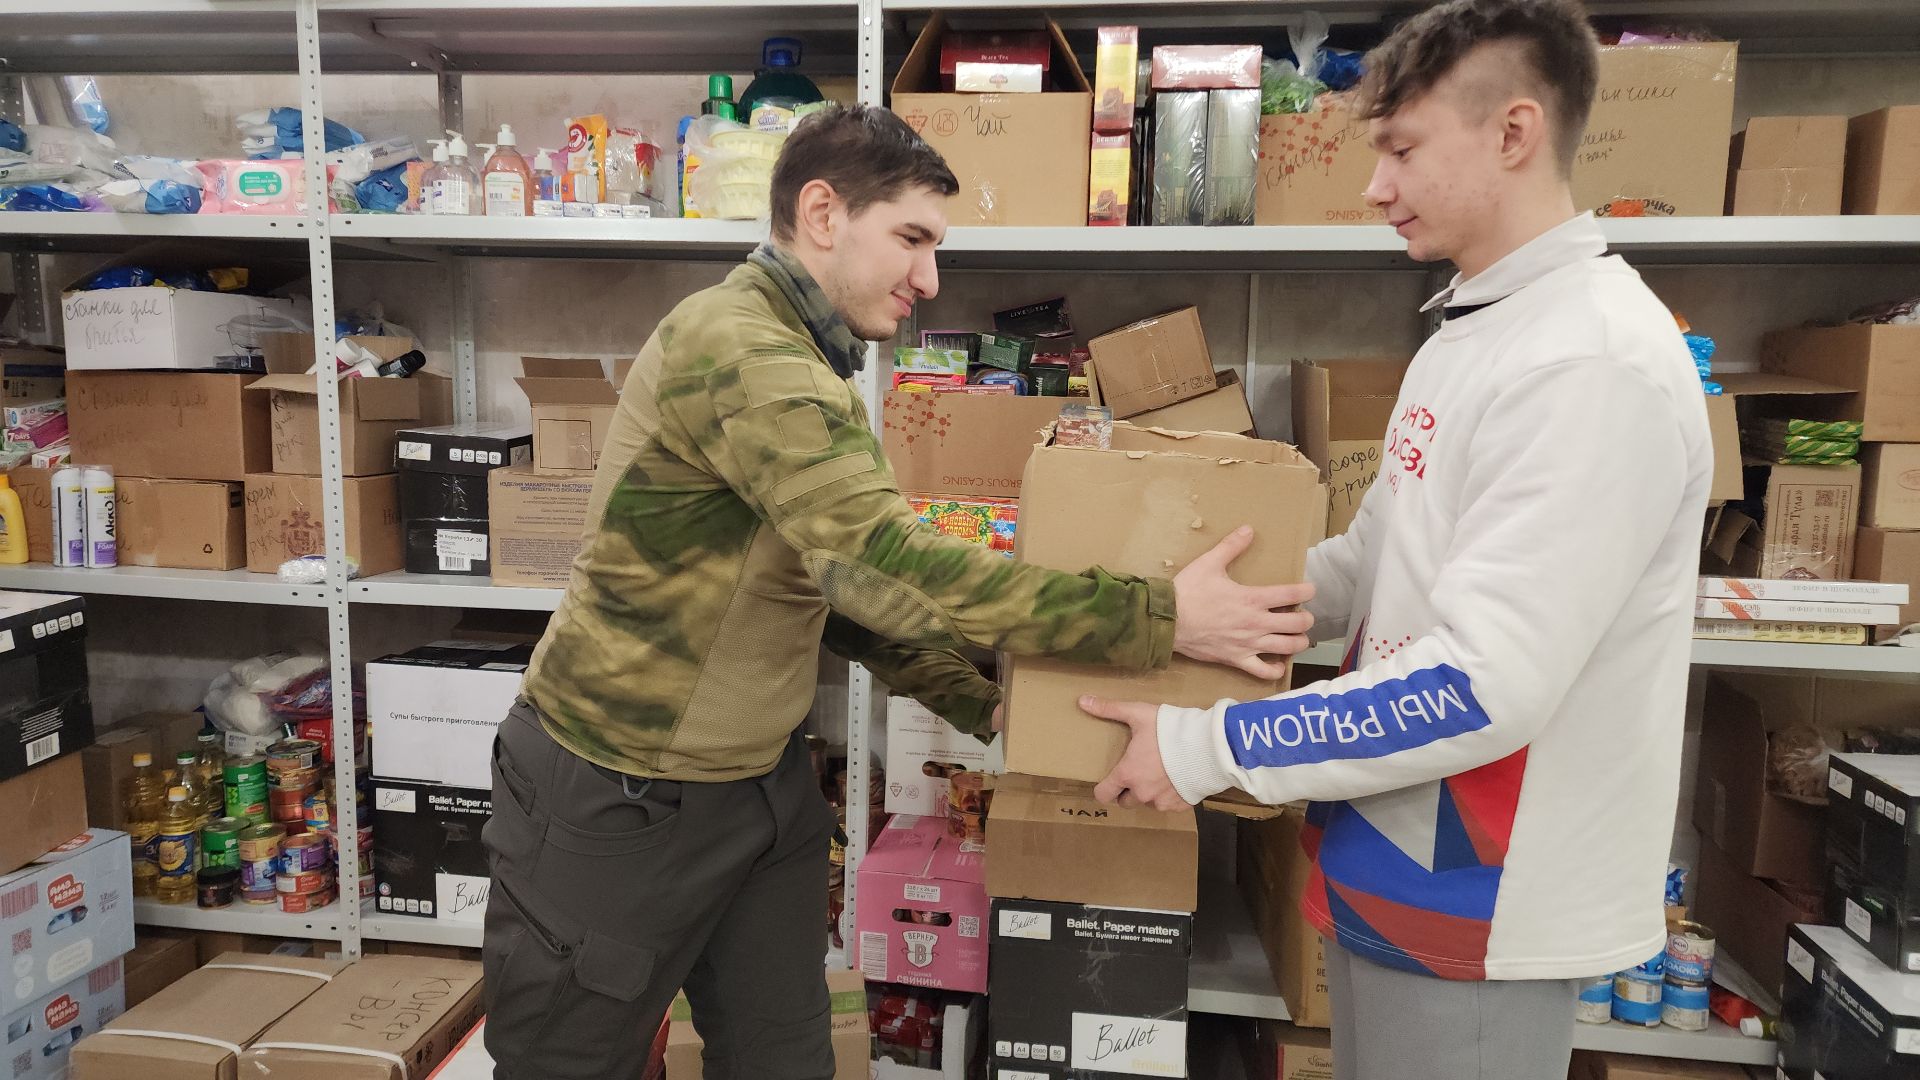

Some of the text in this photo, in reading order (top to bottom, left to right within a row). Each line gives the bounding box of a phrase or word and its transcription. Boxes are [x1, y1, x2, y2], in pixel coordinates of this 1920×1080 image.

[963, 105, 1011, 137] Чай
[1595, 198, 1676, 217] сеочка
[1325, 210, 1375, 221] CASING
[1010, 310, 1026, 318] LIVE
[942, 475, 984, 487] CASING
[389, 711, 500, 728] Супы быстрого приготовлени
[1238, 683, 1469, 750] МЫ РЯДОМ
[428, 795, 455, 805] Ballet.
[456, 797, 482, 808] Paper
[1060, 808, 1108, 817] ЧАЙ
[1066, 918, 1180, 937] Ballet. Paper matters
[908, 932, 934, 942] ВЕРНЕР
[1074, 930, 1173, 944] Ballet. Бумага имеет значение
[896, 974, 943, 987] СВИНИНА
[1086, 1023, 1160, 1062] Ballet
